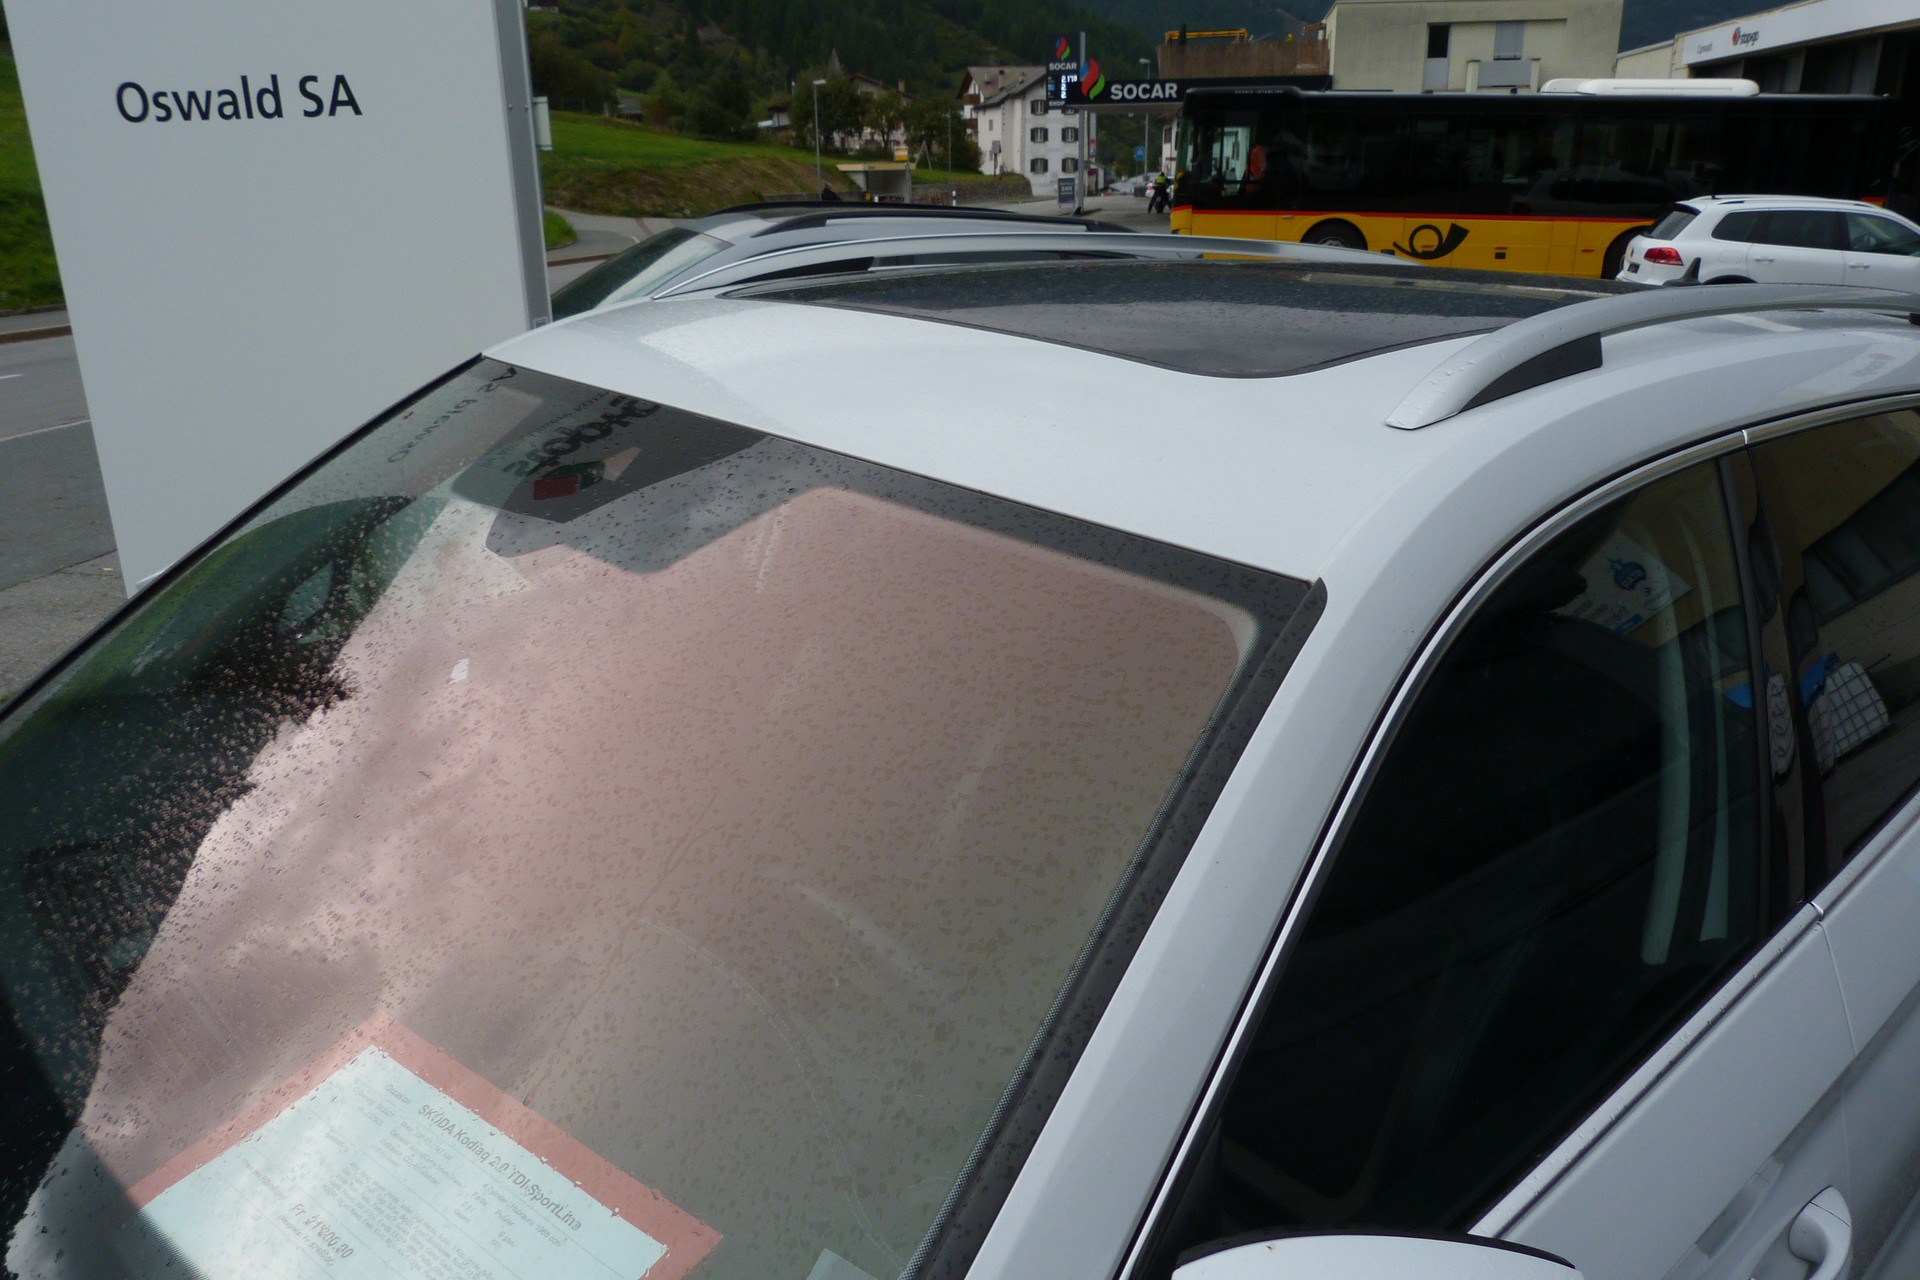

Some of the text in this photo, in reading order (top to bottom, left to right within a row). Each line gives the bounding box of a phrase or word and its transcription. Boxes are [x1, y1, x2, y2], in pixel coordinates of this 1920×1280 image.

[1049, 62, 1077, 70] SOCAR
[116, 74, 363, 123] Oswald SA
[1110, 83, 1178, 100] SOCAR
[452, 1129, 491, 1163] Kodiaq
[505, 1165, 530, 1188] TDI
